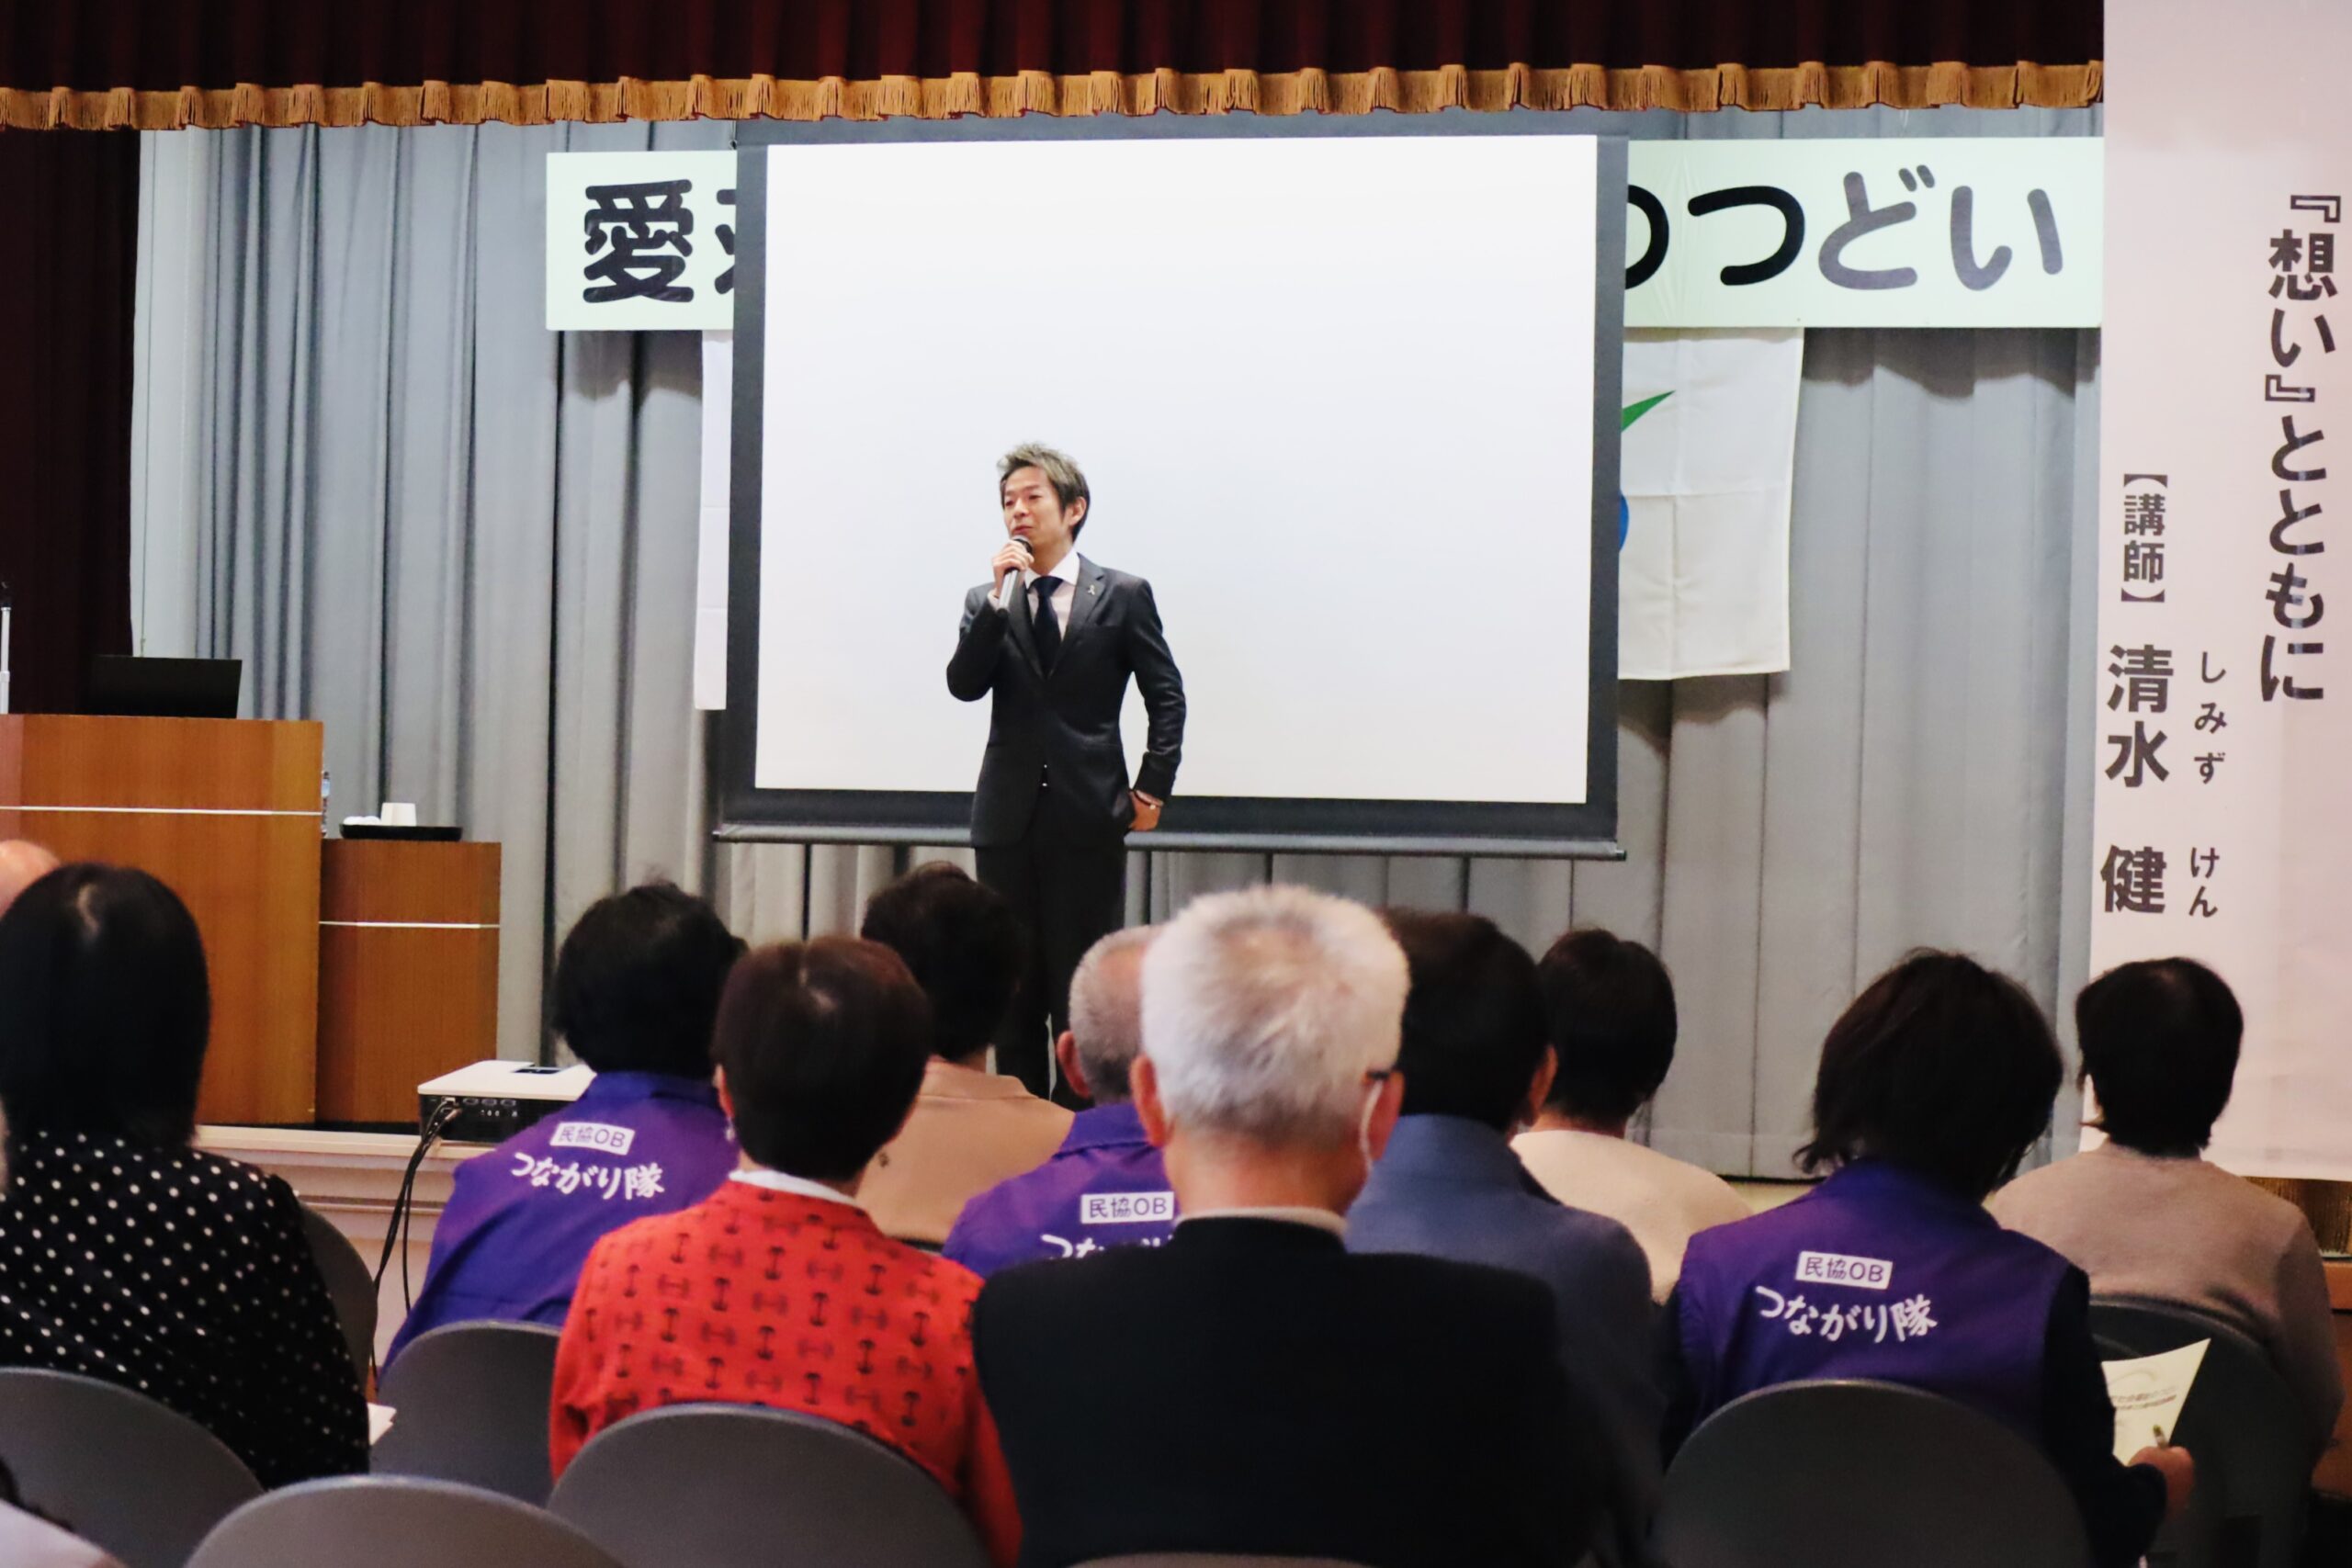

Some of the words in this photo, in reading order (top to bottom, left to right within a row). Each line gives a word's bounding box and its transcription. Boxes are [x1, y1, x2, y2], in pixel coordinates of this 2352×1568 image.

[583, 179, 736, 303] 愛
[2259, 195, 2341, 702] 『想い』とともに
[2120, 473, 2168, 603] 【講師】
[2105, 644, 2174, 787] 清水
[2194, 651, 2227, 784] しみず
[2100, 844, 2167, 913] 健
[2189, 847, 2220, 918] けん
[558, 1125, 626, 1148] 民協OB
[511, 1152, 665, 1200] つながり隊
[1090, 1197, 1167, 1219] 民協OB
[1804, 1256, 1883, 1282] 民協OB
[1756, 1286, 1938, 1343] つながり隊
